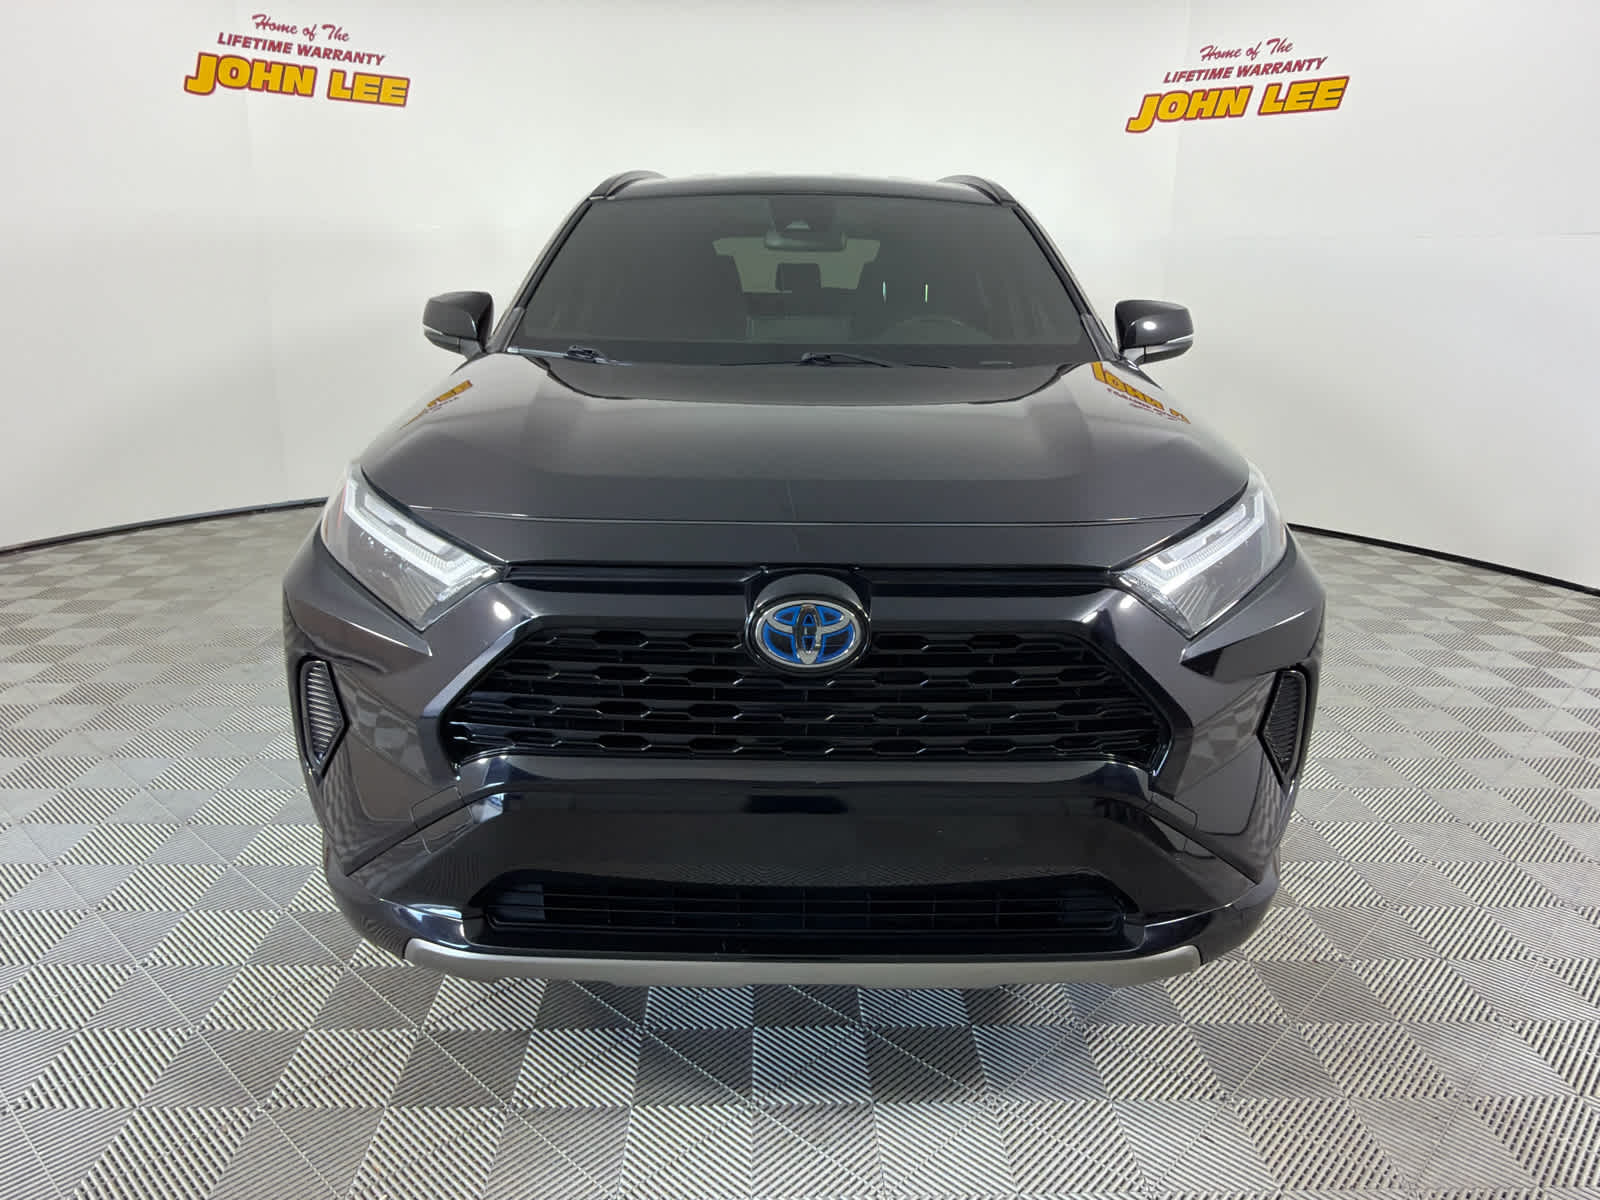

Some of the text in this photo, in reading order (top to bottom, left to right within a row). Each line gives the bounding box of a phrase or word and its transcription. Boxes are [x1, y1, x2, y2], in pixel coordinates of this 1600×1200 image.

[252, 14, 350, 42] Home of The
[217, 32, 385, 66] LIFETIME WARRANTY
[1200, 37, 1293, 61] Home of The
[184, 52, 410, 107] JOHN LEE
[1163, 56, 1328, 83] LIFETIME WARRANTY
[1125, 76, 1350, 133] JOHN LEE
